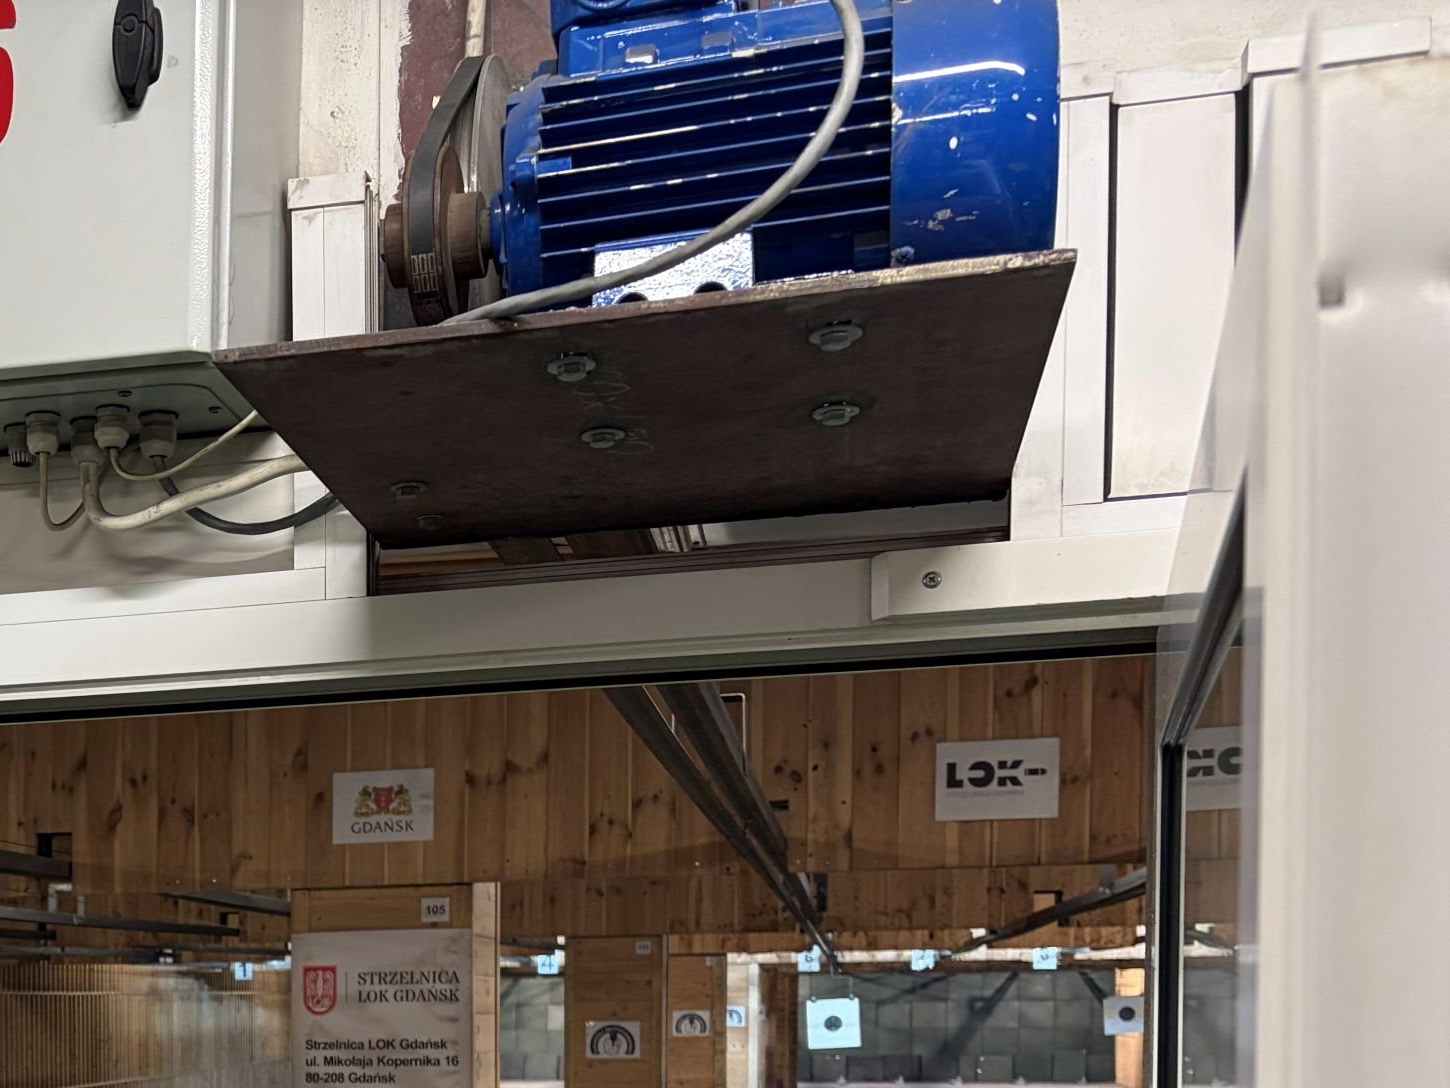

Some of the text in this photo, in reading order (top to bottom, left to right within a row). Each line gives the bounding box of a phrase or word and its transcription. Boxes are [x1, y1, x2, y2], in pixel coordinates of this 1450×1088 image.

[946, 759, 1024, 789] LOK
[350, 816, 415, 834] GDAŃSK
[357, 970, 460, 986] STRZELNICA
[357, 985, 460, 1003] LOK GDAŃSK
[305, 1038, 448, 1050] Strzelnica LOK Gdańsk
[305, 1055, 459, 1069] ul. Mikołaja Kopernika 16
[305, 1072, 396, 1083] 80-208 Gdańsk
